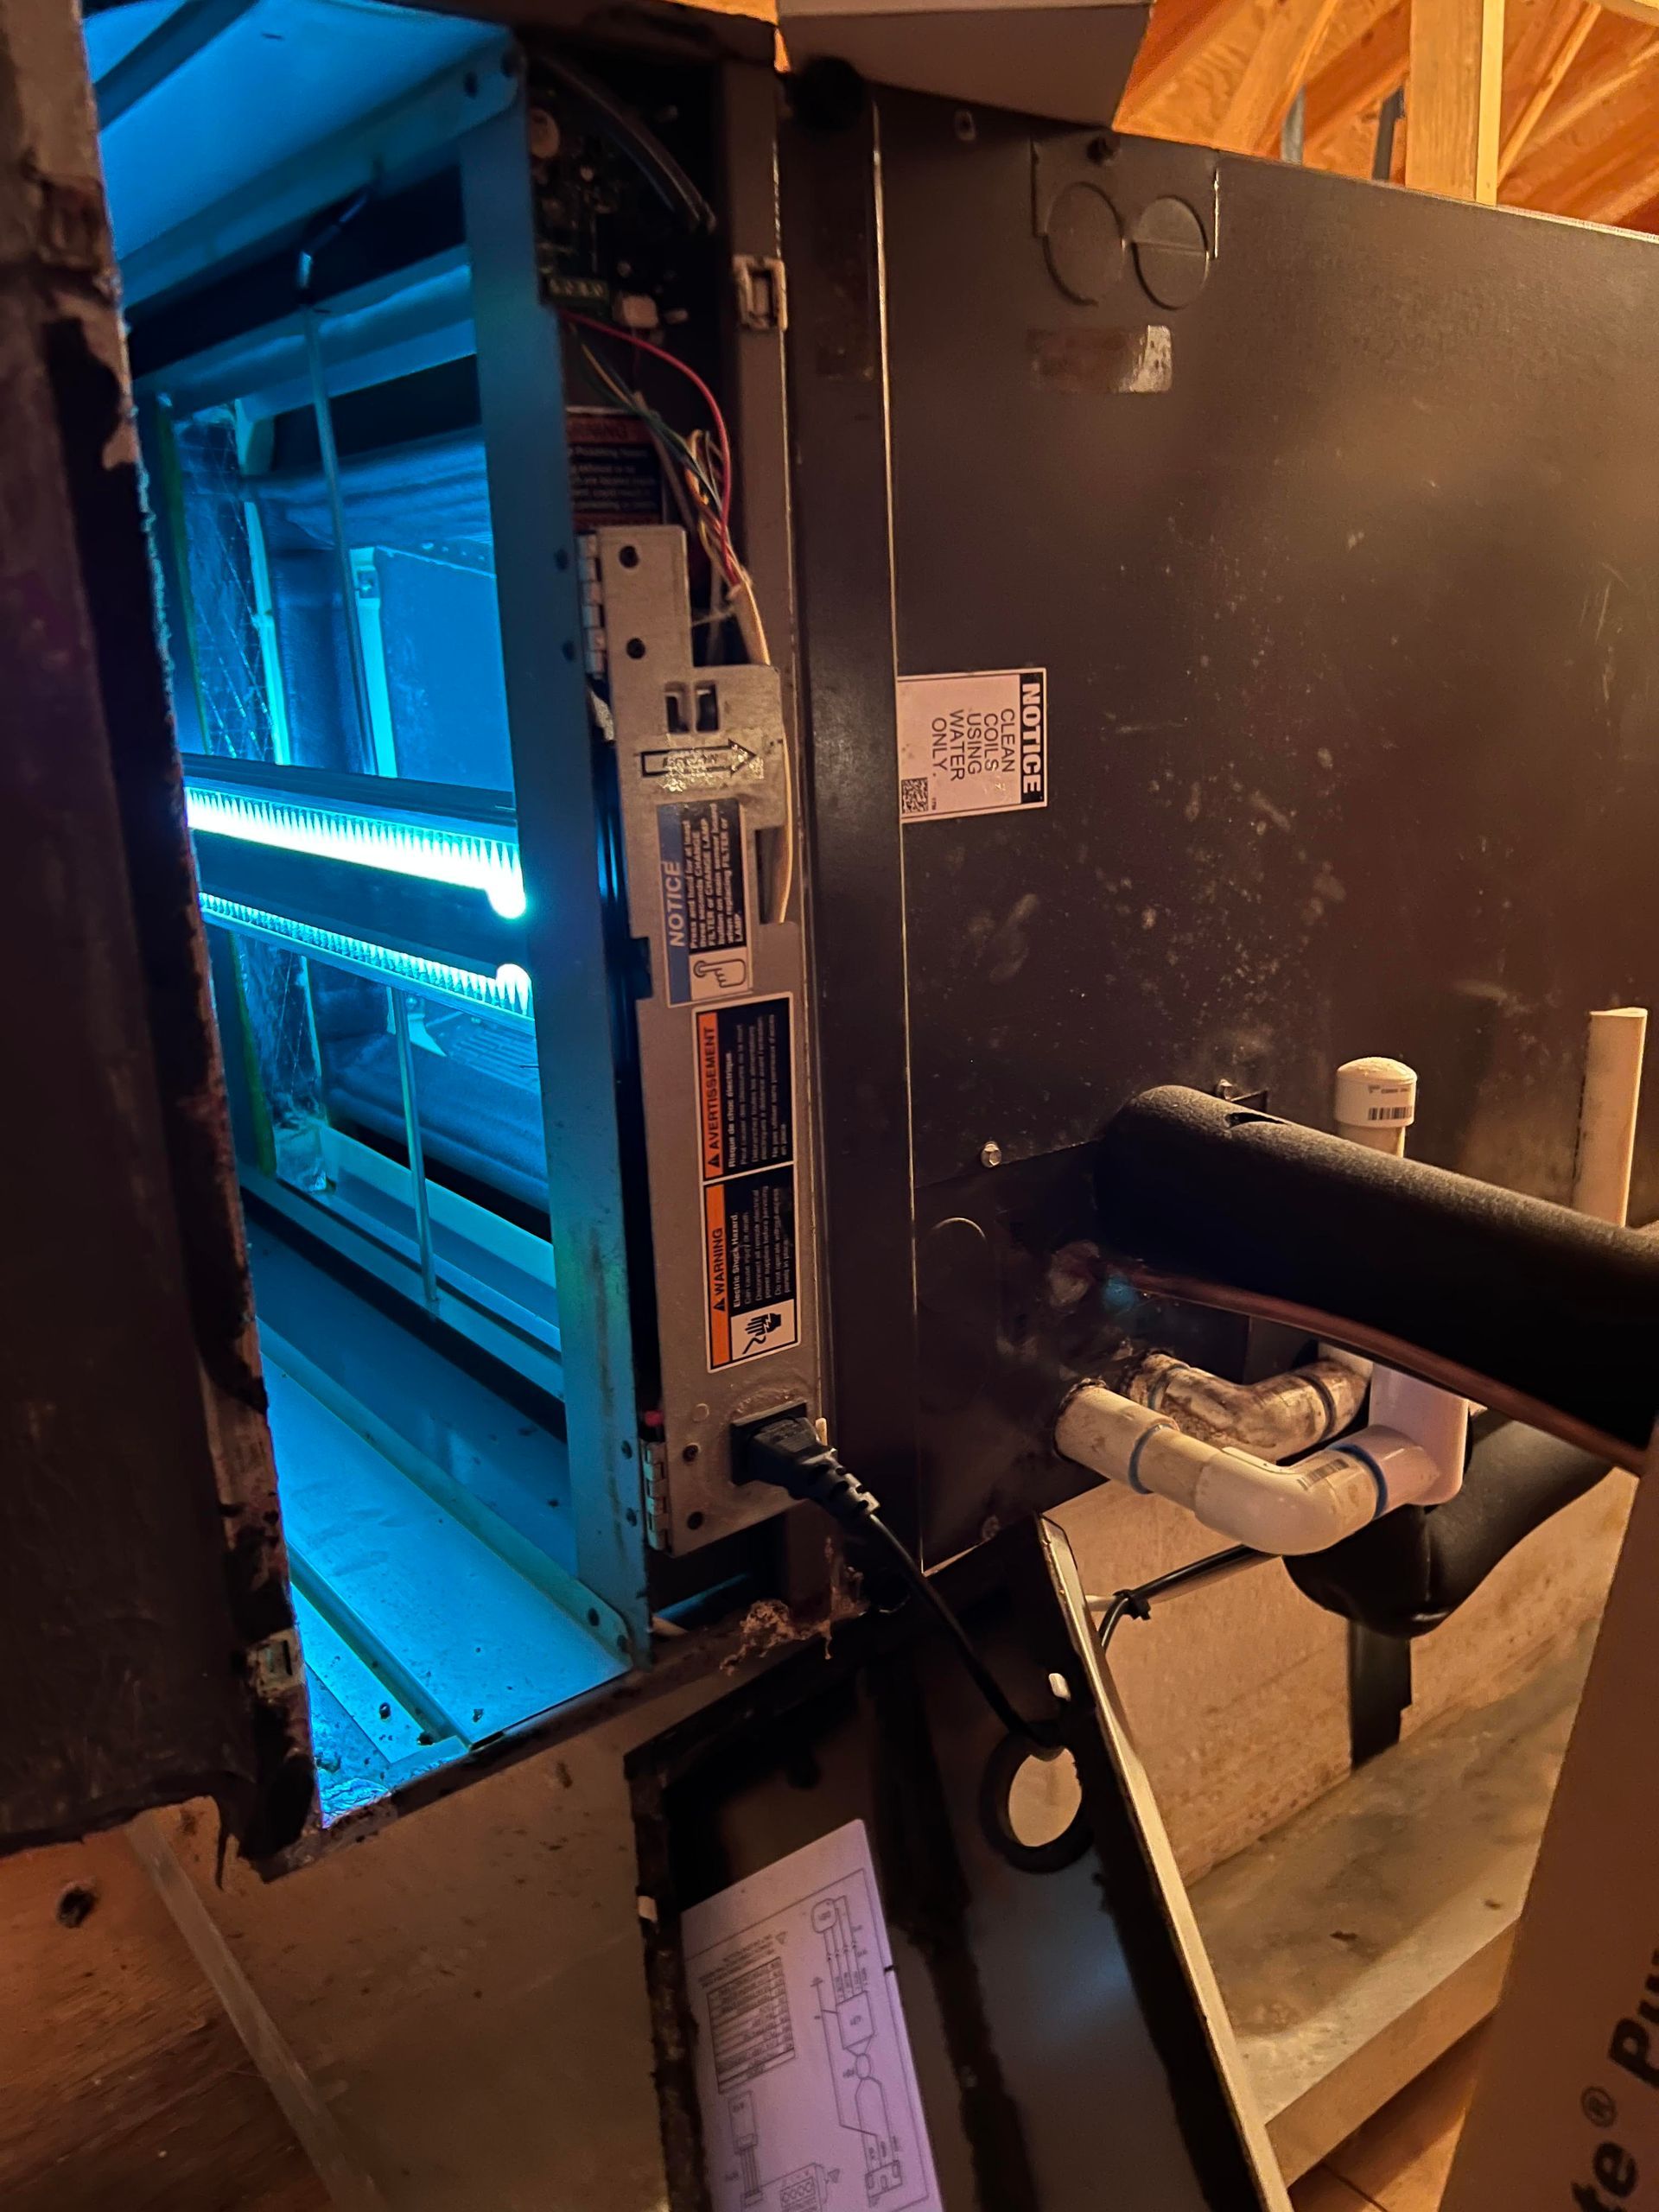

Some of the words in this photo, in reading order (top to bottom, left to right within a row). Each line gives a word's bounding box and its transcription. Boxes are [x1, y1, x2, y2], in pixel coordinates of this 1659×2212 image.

[931, 717, 948, 778] ONLY.
[950, 709, 965, 782] WATER
[967, 713, 982, 775] USING
[984, 713, 999, 772] COILS
[1001, 708, 1015, 772] CLEAN
[1022, 683, 1041, 794] NOTICE
[684, 847, 692, 857] at
[701, 818, 709, 849] LAMP
[720, 831, 730, 868] FILTER
[692, 831, 702, 876] CHANGE
[685, 876, 695, 899] hold
[702, 851, 713, 896] CHANGE
[723, 869, 733, 916] replacing
[664, 861, 684, 947] NOTICE
[688, 900, 696, 918] and
[696, 879, 706, 920] seconds
[707, 898, 714, 908] or
[716, 898, 723, 912] on
[690, 921, 698, 949] Press
[706, 911, 715, 946] FILTER
[726, 918, 734, 944] when
[703, 1027, 719, 1149] AVERTISSEMENT
[728, 1123, 735, 1135] de
[728, 1136, 736, 1168] Risque
[713, 1227, 725, 1295] WARNING
[732, 1245, 741, 1274] Shock
